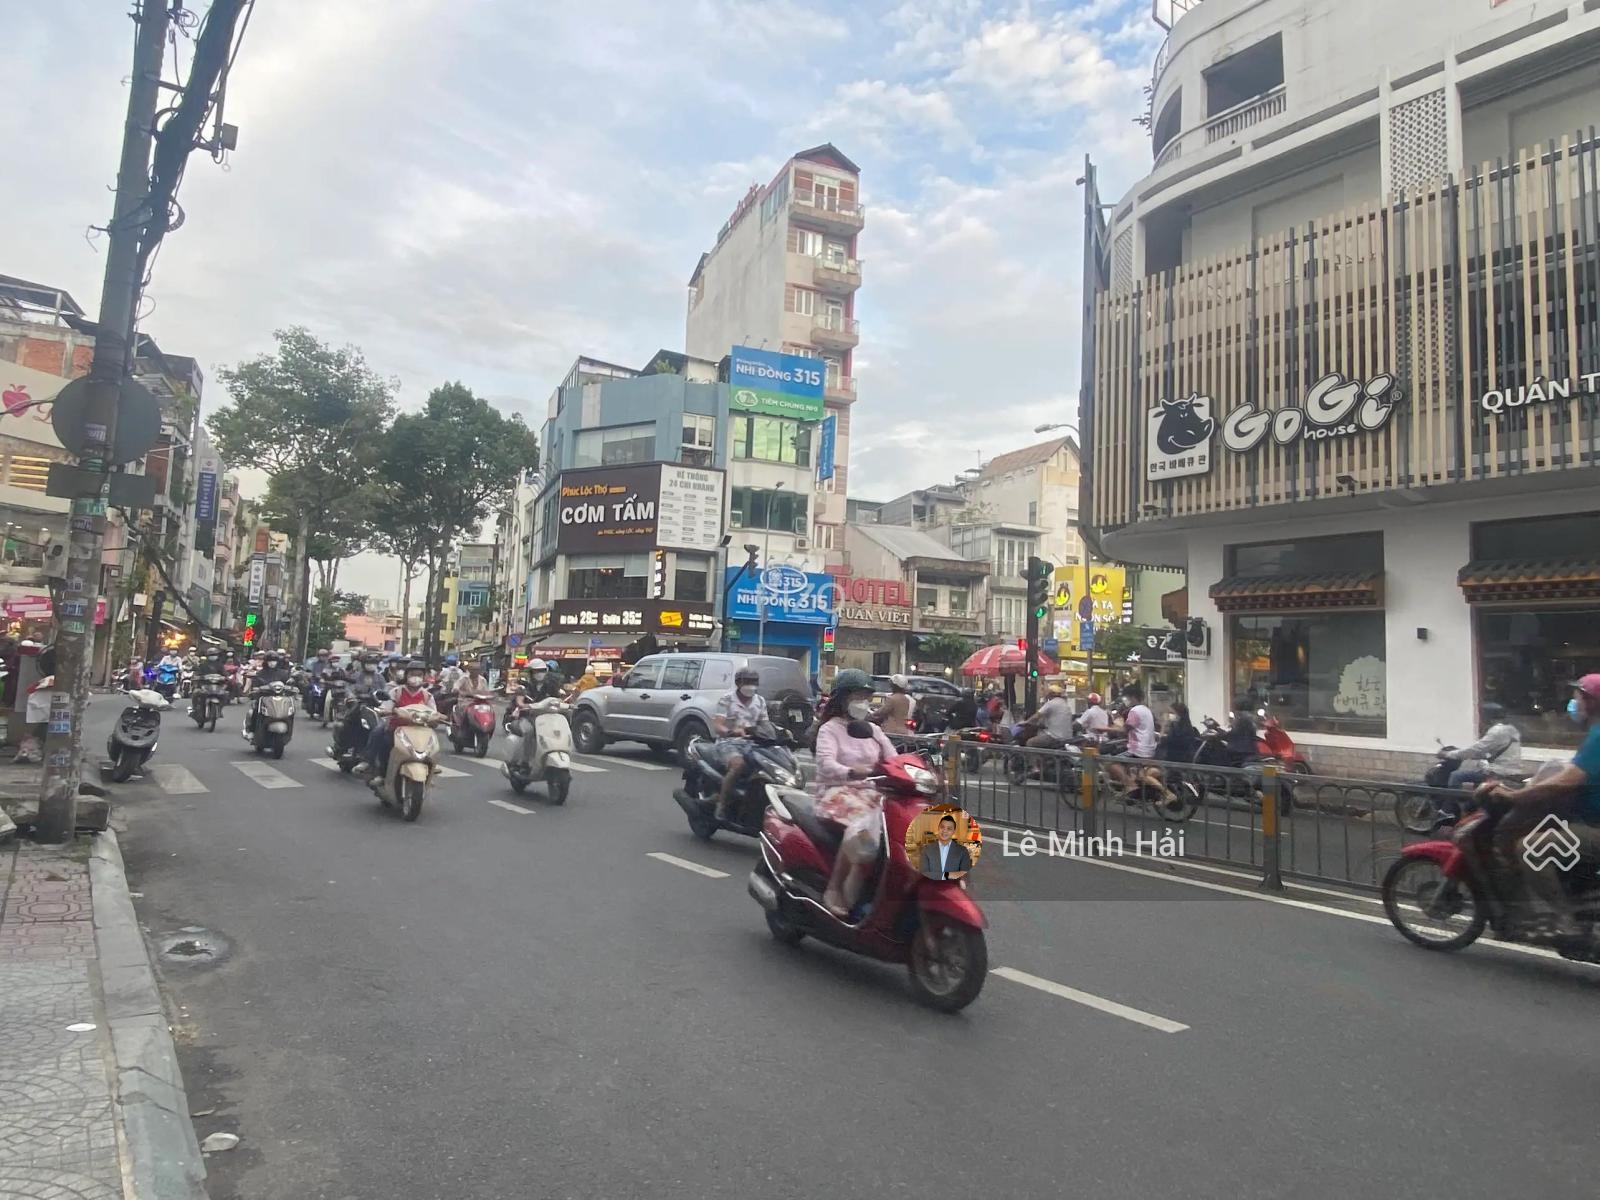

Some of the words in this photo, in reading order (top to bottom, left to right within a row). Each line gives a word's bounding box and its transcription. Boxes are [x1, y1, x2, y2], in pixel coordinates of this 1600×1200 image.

[736, 363, 755, 375] NHI
[758, 365, 791, 381] ĐỒNG
[793, 368, 820, 386] 315
[1482, 376, 1569, 414] QUÁN
[1304, 423, 1357, 441] house
[561, 503, 605, 524] CƠM
[612, 493, 655, 521] TẤM
[800, 594, 828, 611] 315
[835, 576, 912, 607] HOTEL
